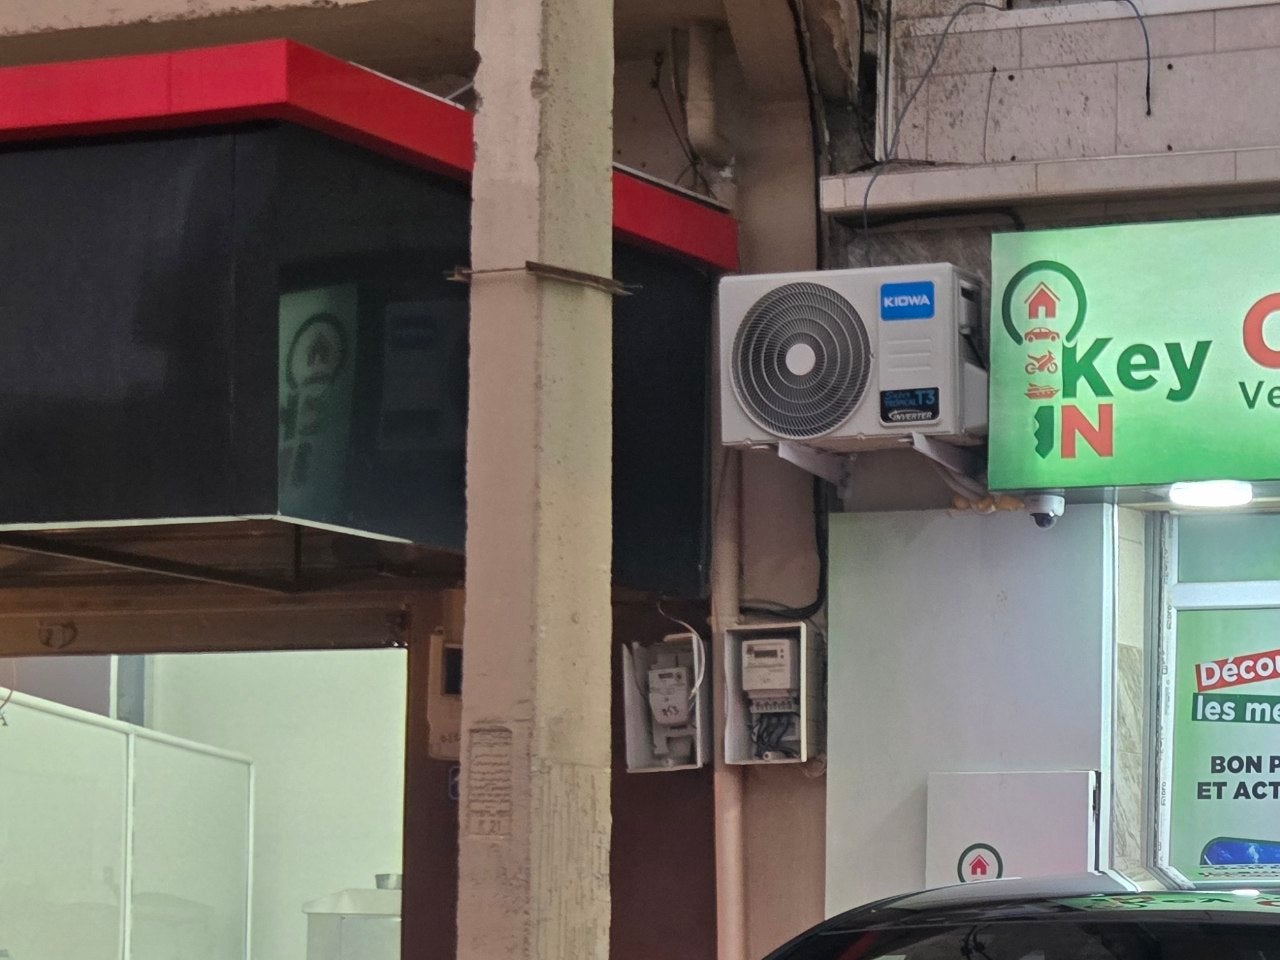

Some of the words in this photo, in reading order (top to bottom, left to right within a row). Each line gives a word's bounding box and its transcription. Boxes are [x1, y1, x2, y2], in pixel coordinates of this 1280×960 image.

[884, 294, 931, 308] KIOWA
[1062, 337, 1212, 402] Key
[1197, 695, 1235, 720] les
[1211, 755, 1262, 773] BON
[1197, 782, 1227, 799] ET
